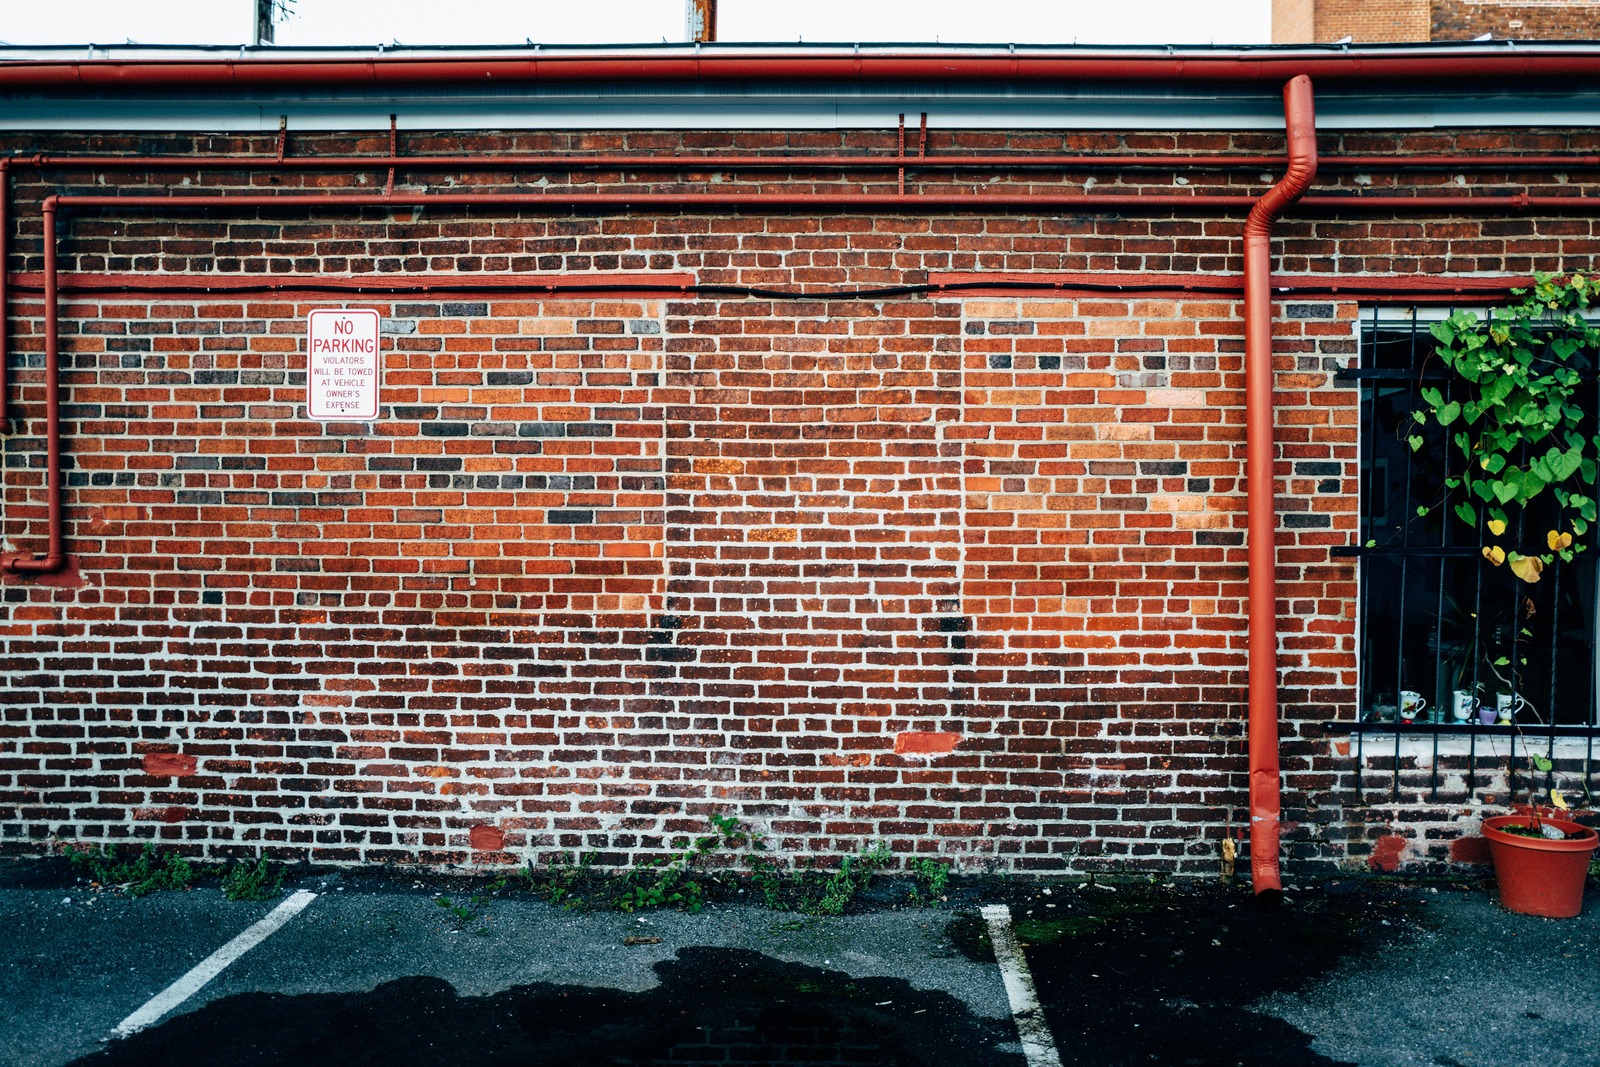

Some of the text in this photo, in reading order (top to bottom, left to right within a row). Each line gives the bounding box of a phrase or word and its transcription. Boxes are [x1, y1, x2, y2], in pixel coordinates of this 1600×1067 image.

[334, 320, 353, 334] NO
[314, 338, 374, 353] PARKING
[323, 356, 364, 364] VIOLATORS
